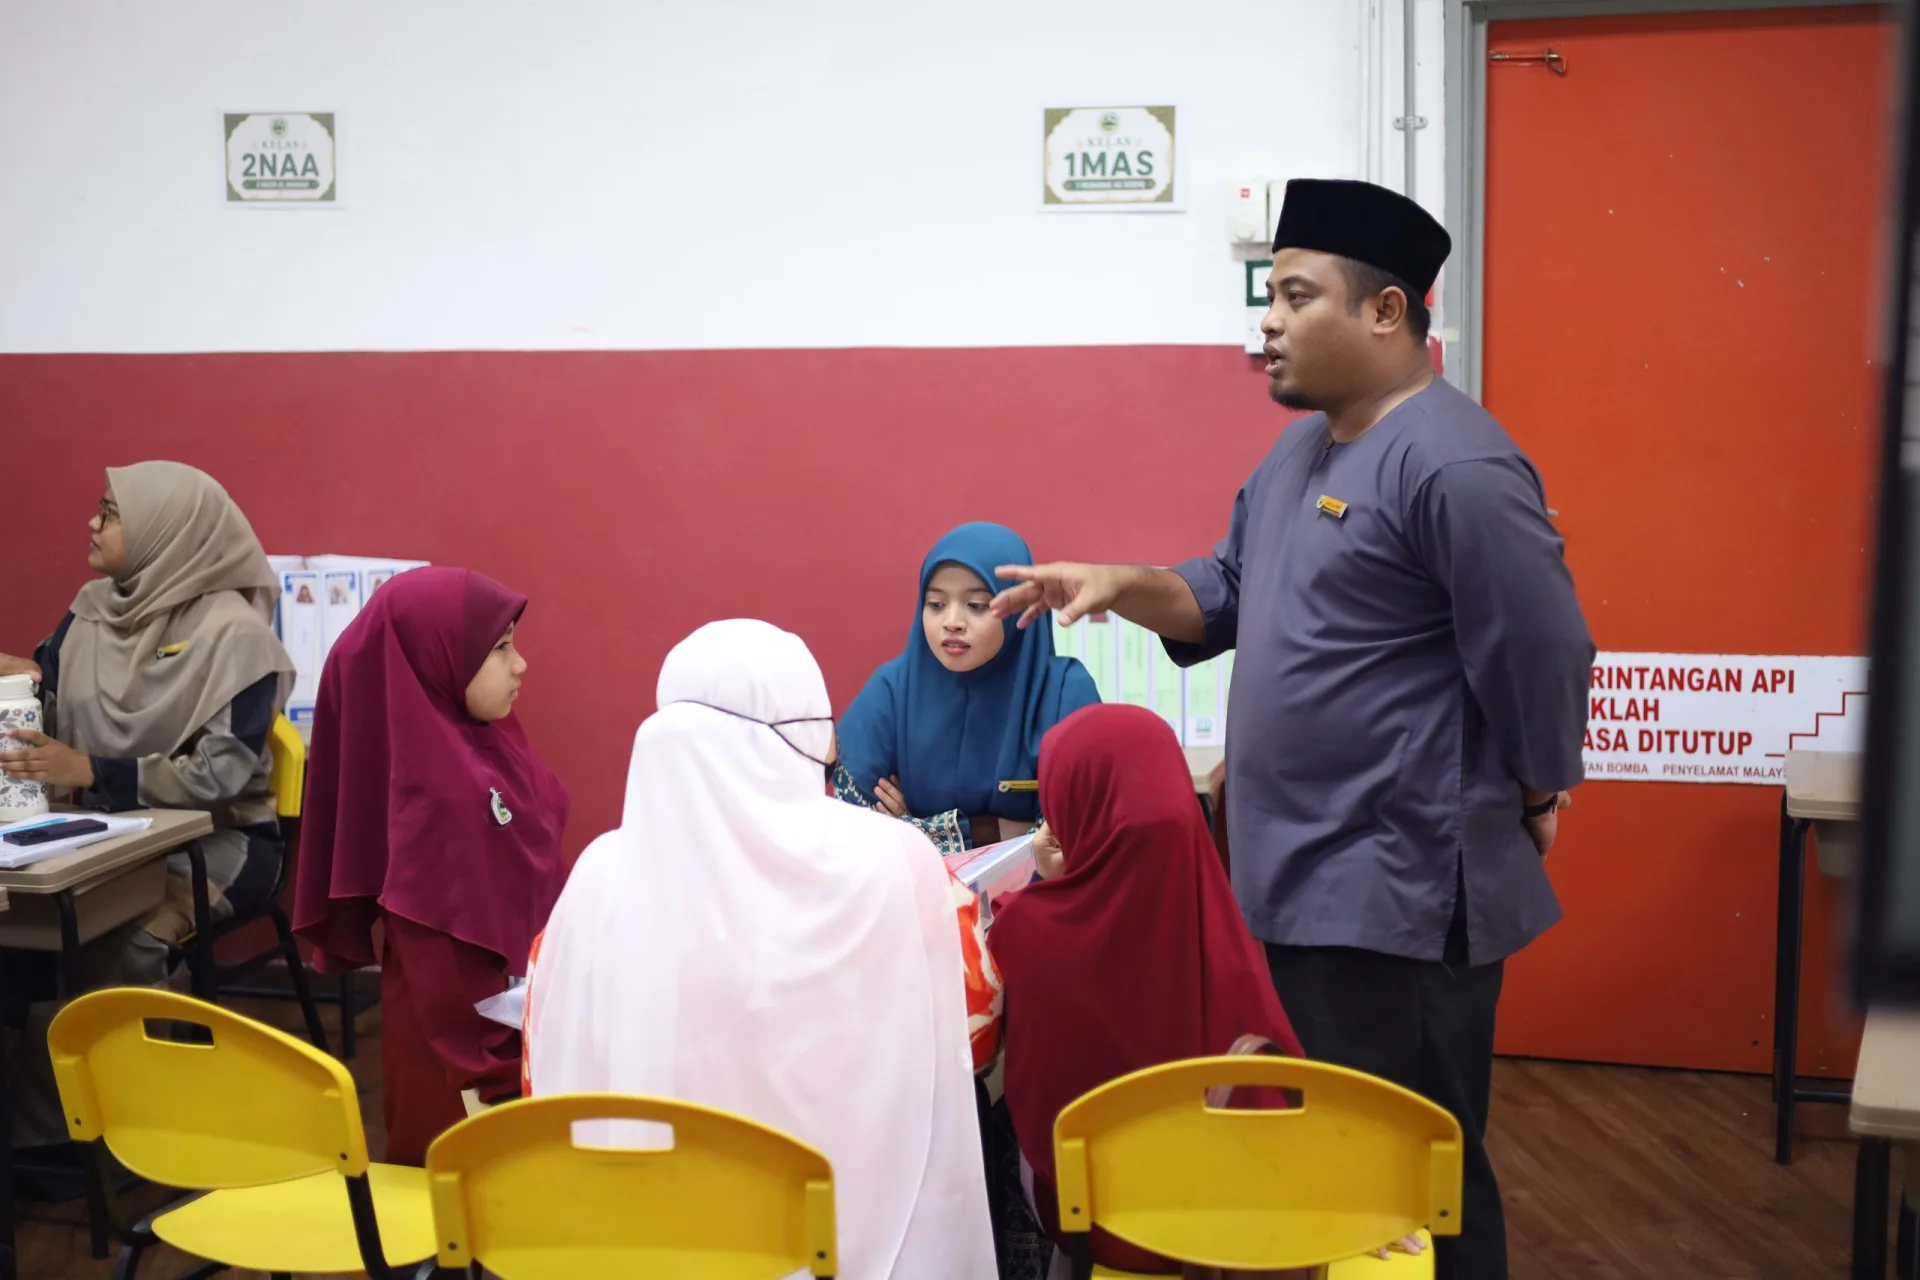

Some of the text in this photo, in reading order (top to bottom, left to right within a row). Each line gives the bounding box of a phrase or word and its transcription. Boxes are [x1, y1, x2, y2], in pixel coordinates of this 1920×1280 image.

[242, 152, 320, 177] 2NAA
[1064, 150, 1155, 177] 1MAS
[1591, 666, 1794, 693] RINTANGAN API
[1591, 697, 1660, 721] KLAH
[1583, 728, 1753, 755] ASA DITUTUP
[1607, 762, 1649, 774] BOMBA
[1663, 763, 1739, 776] PENYELAMAT
